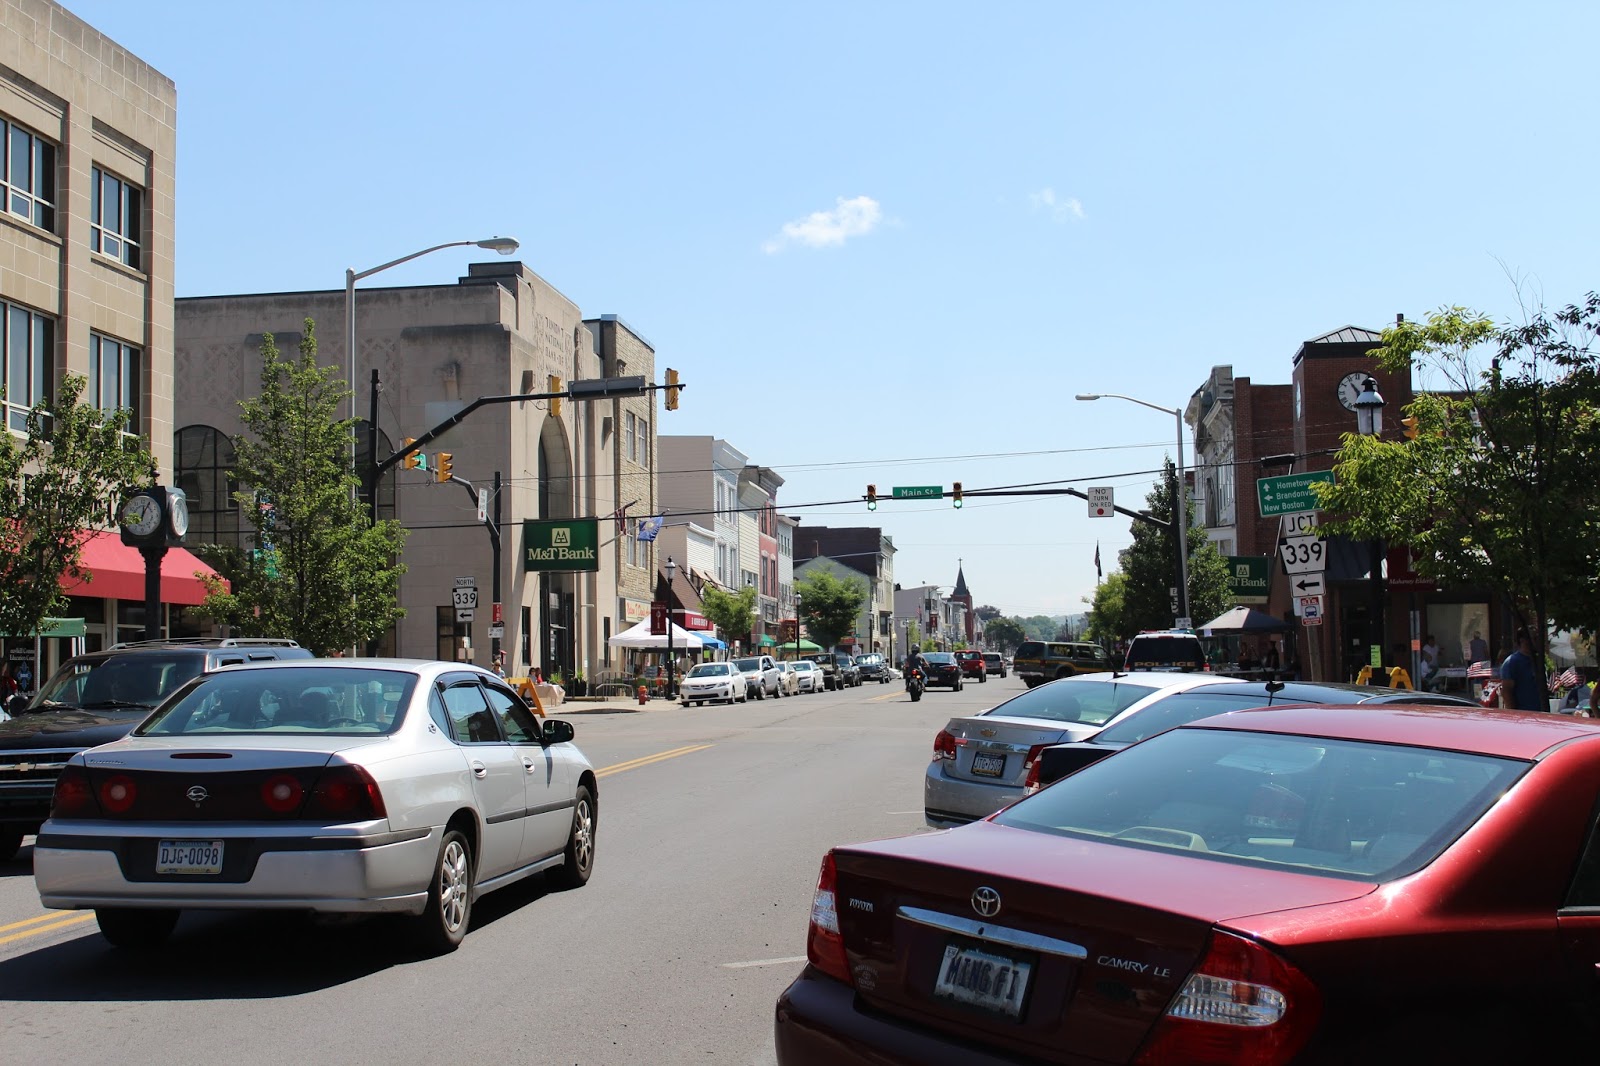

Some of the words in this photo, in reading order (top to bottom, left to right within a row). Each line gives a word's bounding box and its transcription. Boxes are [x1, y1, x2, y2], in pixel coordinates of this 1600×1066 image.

[902, 489, 922, 497] Main
[1282, 502, 1305, 510] Boston
[1288, 515, 1314, 532] JCT
[528, 548, 558, 561] M&T
[558, 547, 595, 560] Bank
[1286, 542, 1322, 565] 339
[1240, 578, 1266, 587] Bank
[455, 593, 476, 604] 339
[849, 898, 874, 912] TOYOTA
[1097, 956, 1149, 973] CAMRY
[1154, 967, 1170, 977] LE
